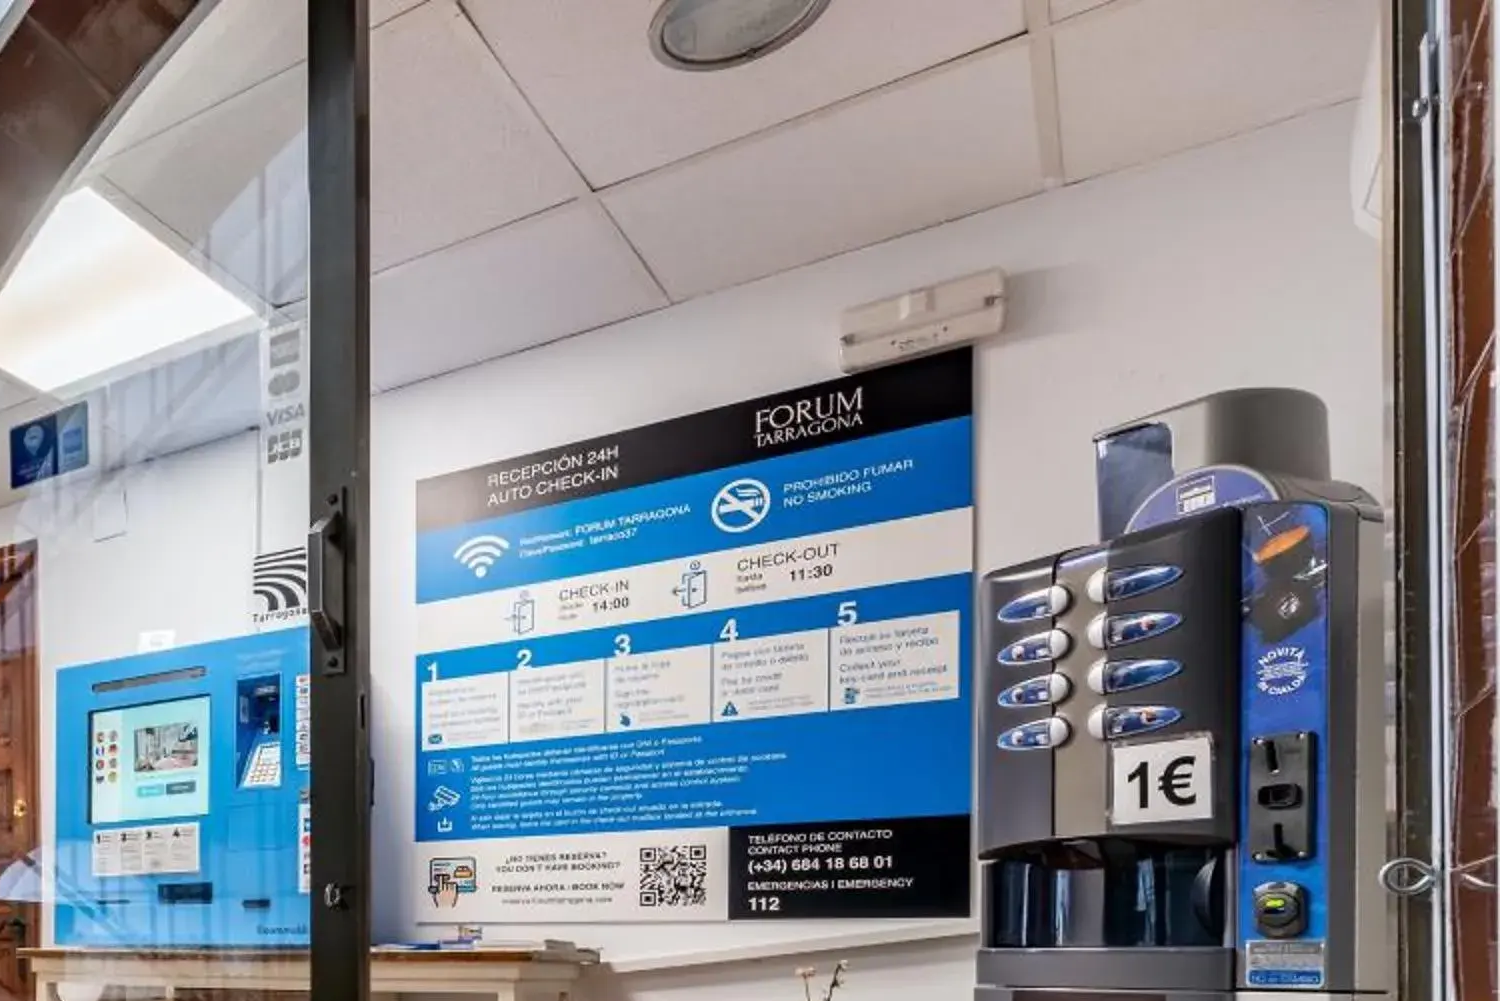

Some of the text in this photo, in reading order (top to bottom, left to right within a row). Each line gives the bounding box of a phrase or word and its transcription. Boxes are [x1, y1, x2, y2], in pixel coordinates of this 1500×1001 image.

[266, 403, 305, 426] VISA
[755, 387, 863, 433] FORUM
[754, 412, 863, 447] TARRAGONA
[487, 446, 618, 487] RECEPCIÓN 24H
[783, 459, 913, 493] PROHIBIDO FUMAR
[487, 465, 618, 506] AUTO CHECK-IN
[783, 482, 872, 507] NO SMOKING
[575, 520, 614, 534] FORUM
[619, 504, 690, 526] TARRAGONA
[737, 543, 840, 572] CHECK-OUT
[790, 562, 832, 582] 11:30
[558, 580, 628, 602] CHECK-IN
[592, 595, 628, 613] 14:00
[837, 600, 857, 626] 5
[719, 617, 738, 642] 4
[615, 633, 630, 656] 3
[516, 647, 532, 670] 2
[427, 661, 438, 682] 1
[1127, 756, 1197, 809] 1€
[809, 831, 824, 841] DE
[827, 828, 892, 841] CONTACTO
[747, 842, 842, 856] CONTACT PHONE
[747, 854, 893, 874] (+34) 684 18 68 01
[747, 879, 828, 891] EMERGENCIAS
[837, 877, 913, 889] EMERGENCY
[748, 896, 780, 911] 112
